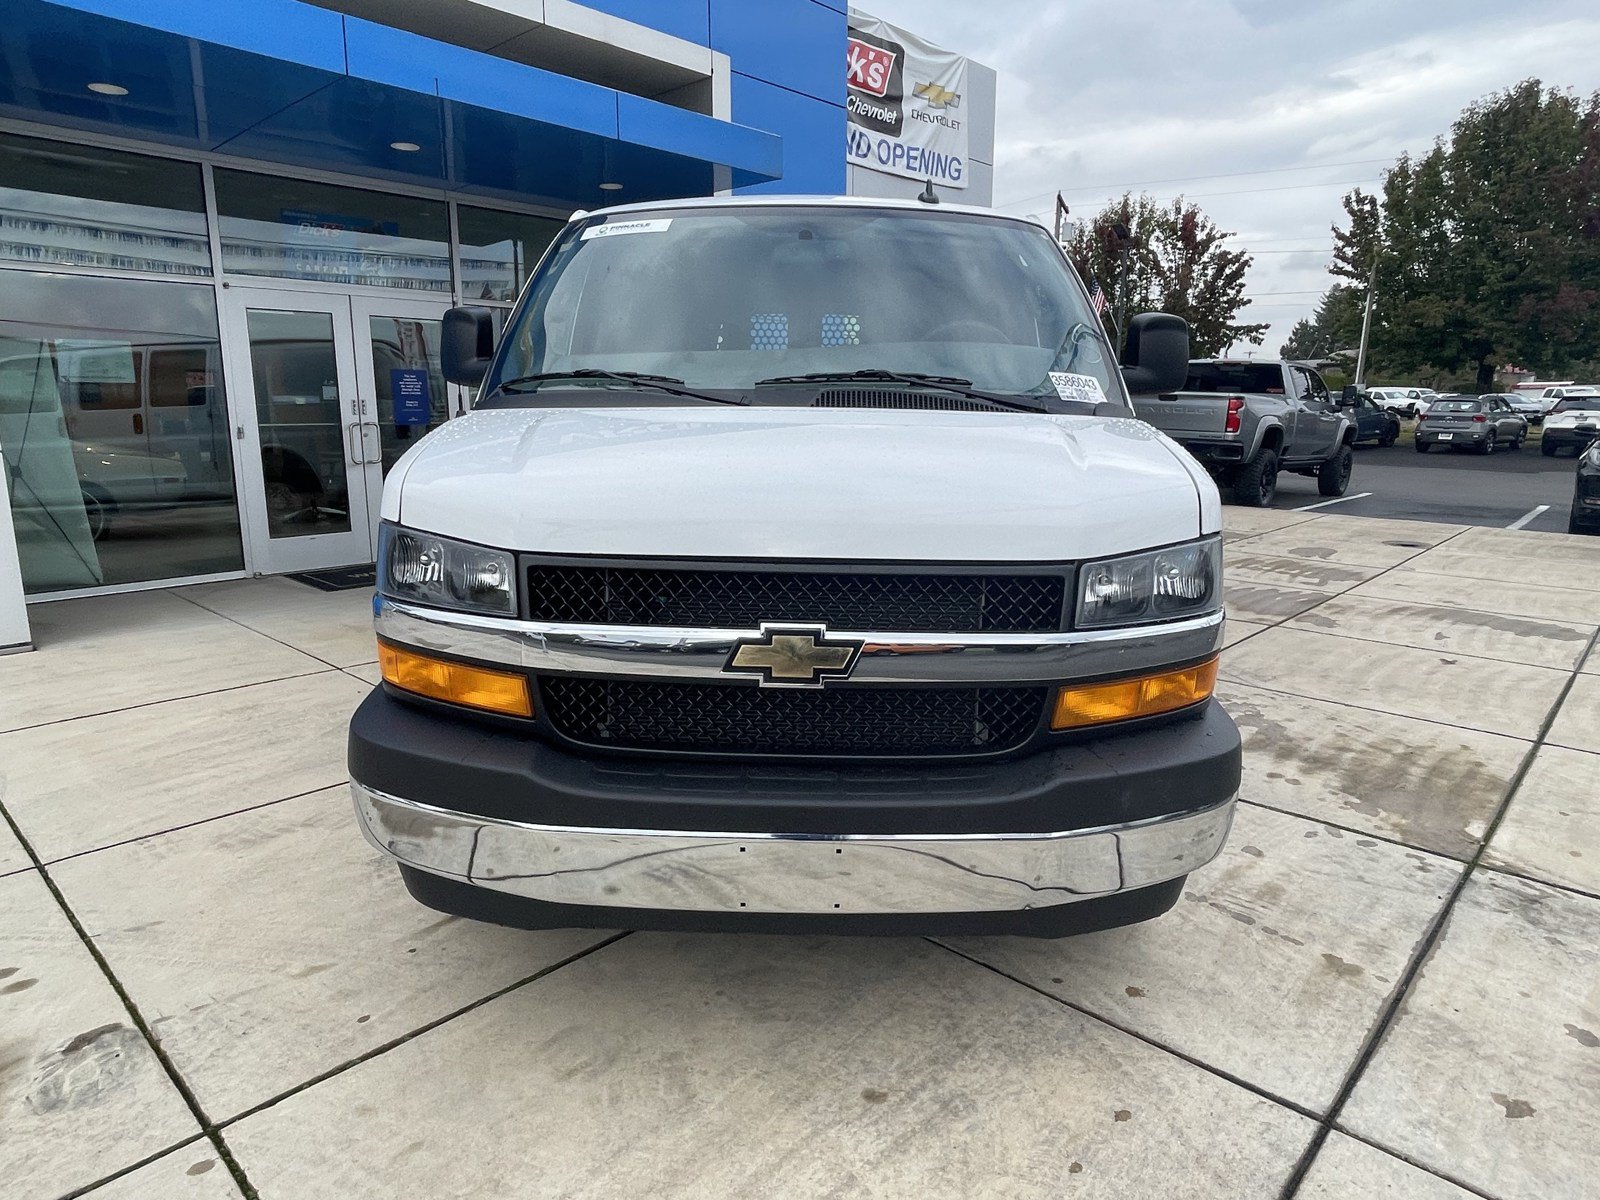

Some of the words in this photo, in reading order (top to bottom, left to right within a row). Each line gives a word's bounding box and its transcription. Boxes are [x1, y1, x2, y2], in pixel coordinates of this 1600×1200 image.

[847, 46, 885, 89] k's
[846, 95, 898, 125] Chevrolet
[911, 109, 961, 131] CHEVROLET
[846, 129, 871, 159] ND
[877, 138, 962, 181] OPENING
[610, 222, 651, 230] PINNACLE
[1051, 374, 1097, 390] 3586043
